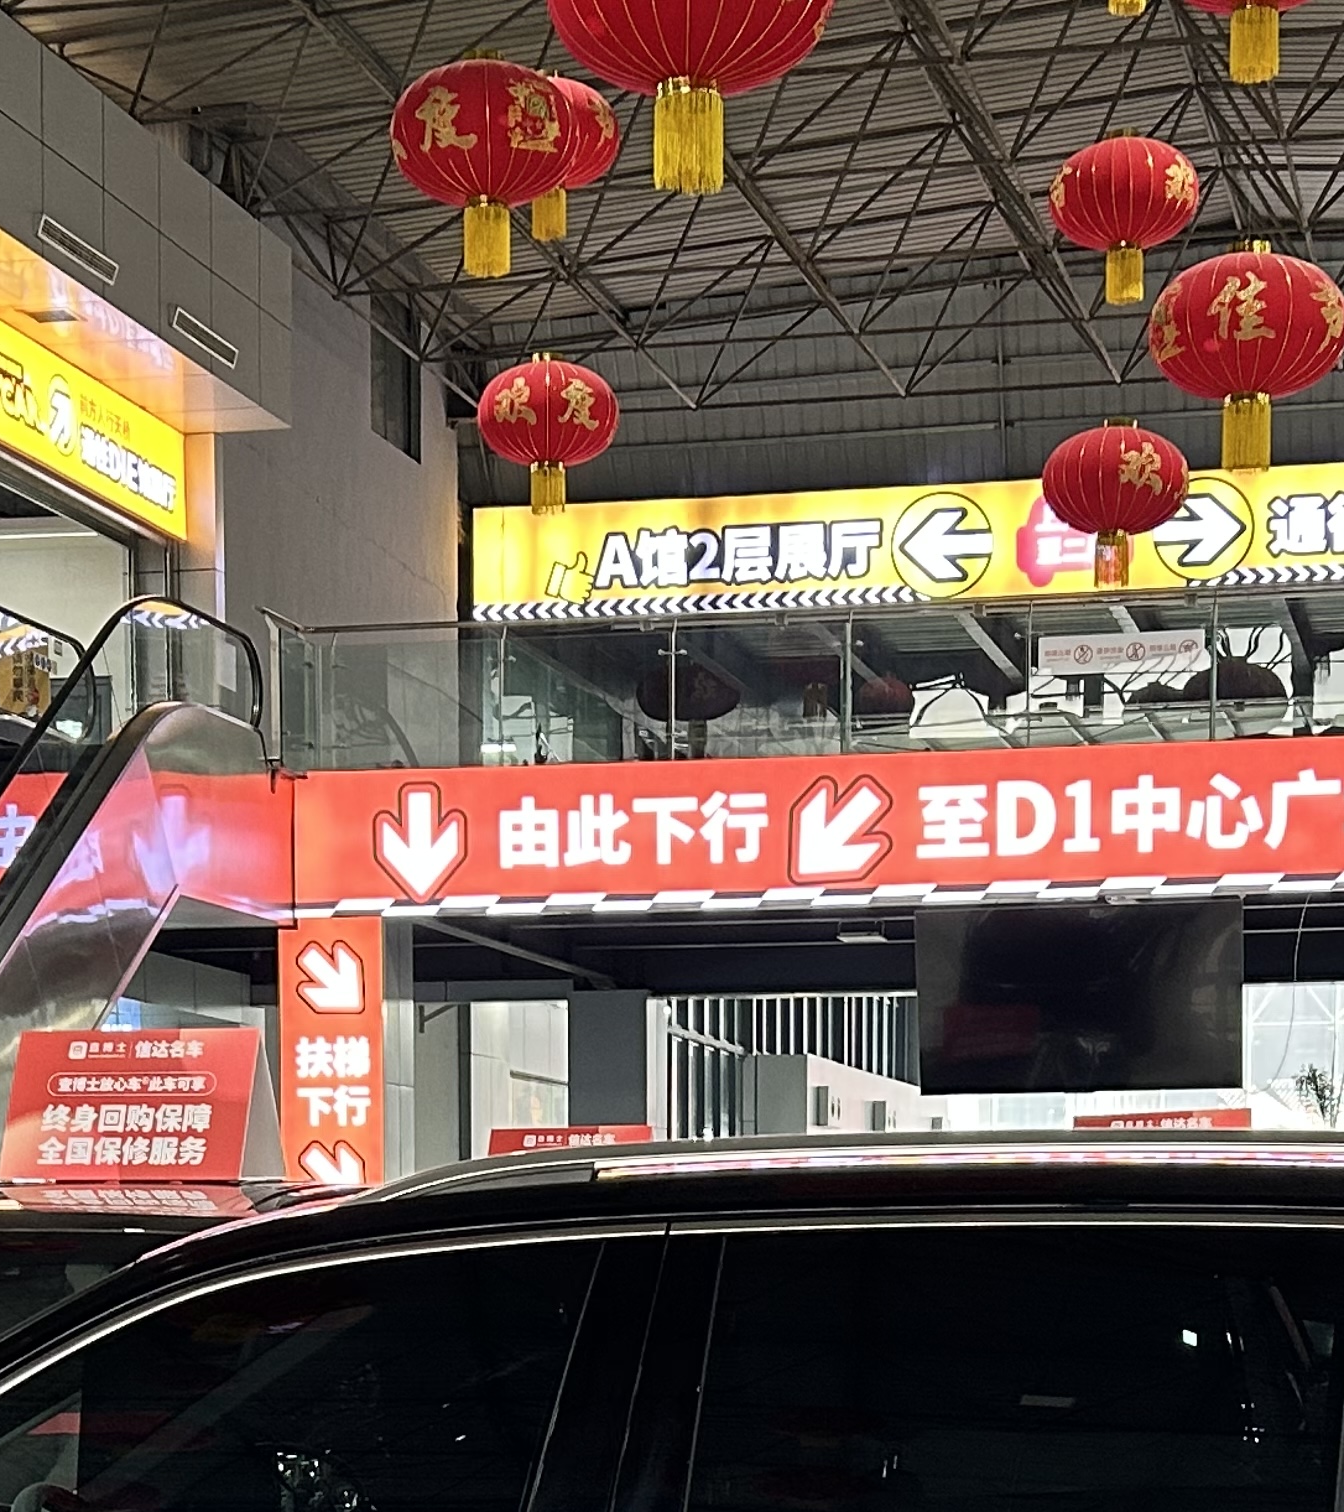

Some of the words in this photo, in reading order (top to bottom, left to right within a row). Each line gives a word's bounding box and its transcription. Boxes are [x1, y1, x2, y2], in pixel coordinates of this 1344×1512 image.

[594, 518, 884, 592] A馆2层展厅
[498, 790, 769, 870] 由此下行
[134, 1040, 204, 1059] 信达名车
[294, 1036, 371, 1080] 扶梯
[40, 1103, 213, 1133] 终身回购保障
[296, 1086, 372, 1126] 下行
[36, 1135, 208, 1166] 全国保修服务
